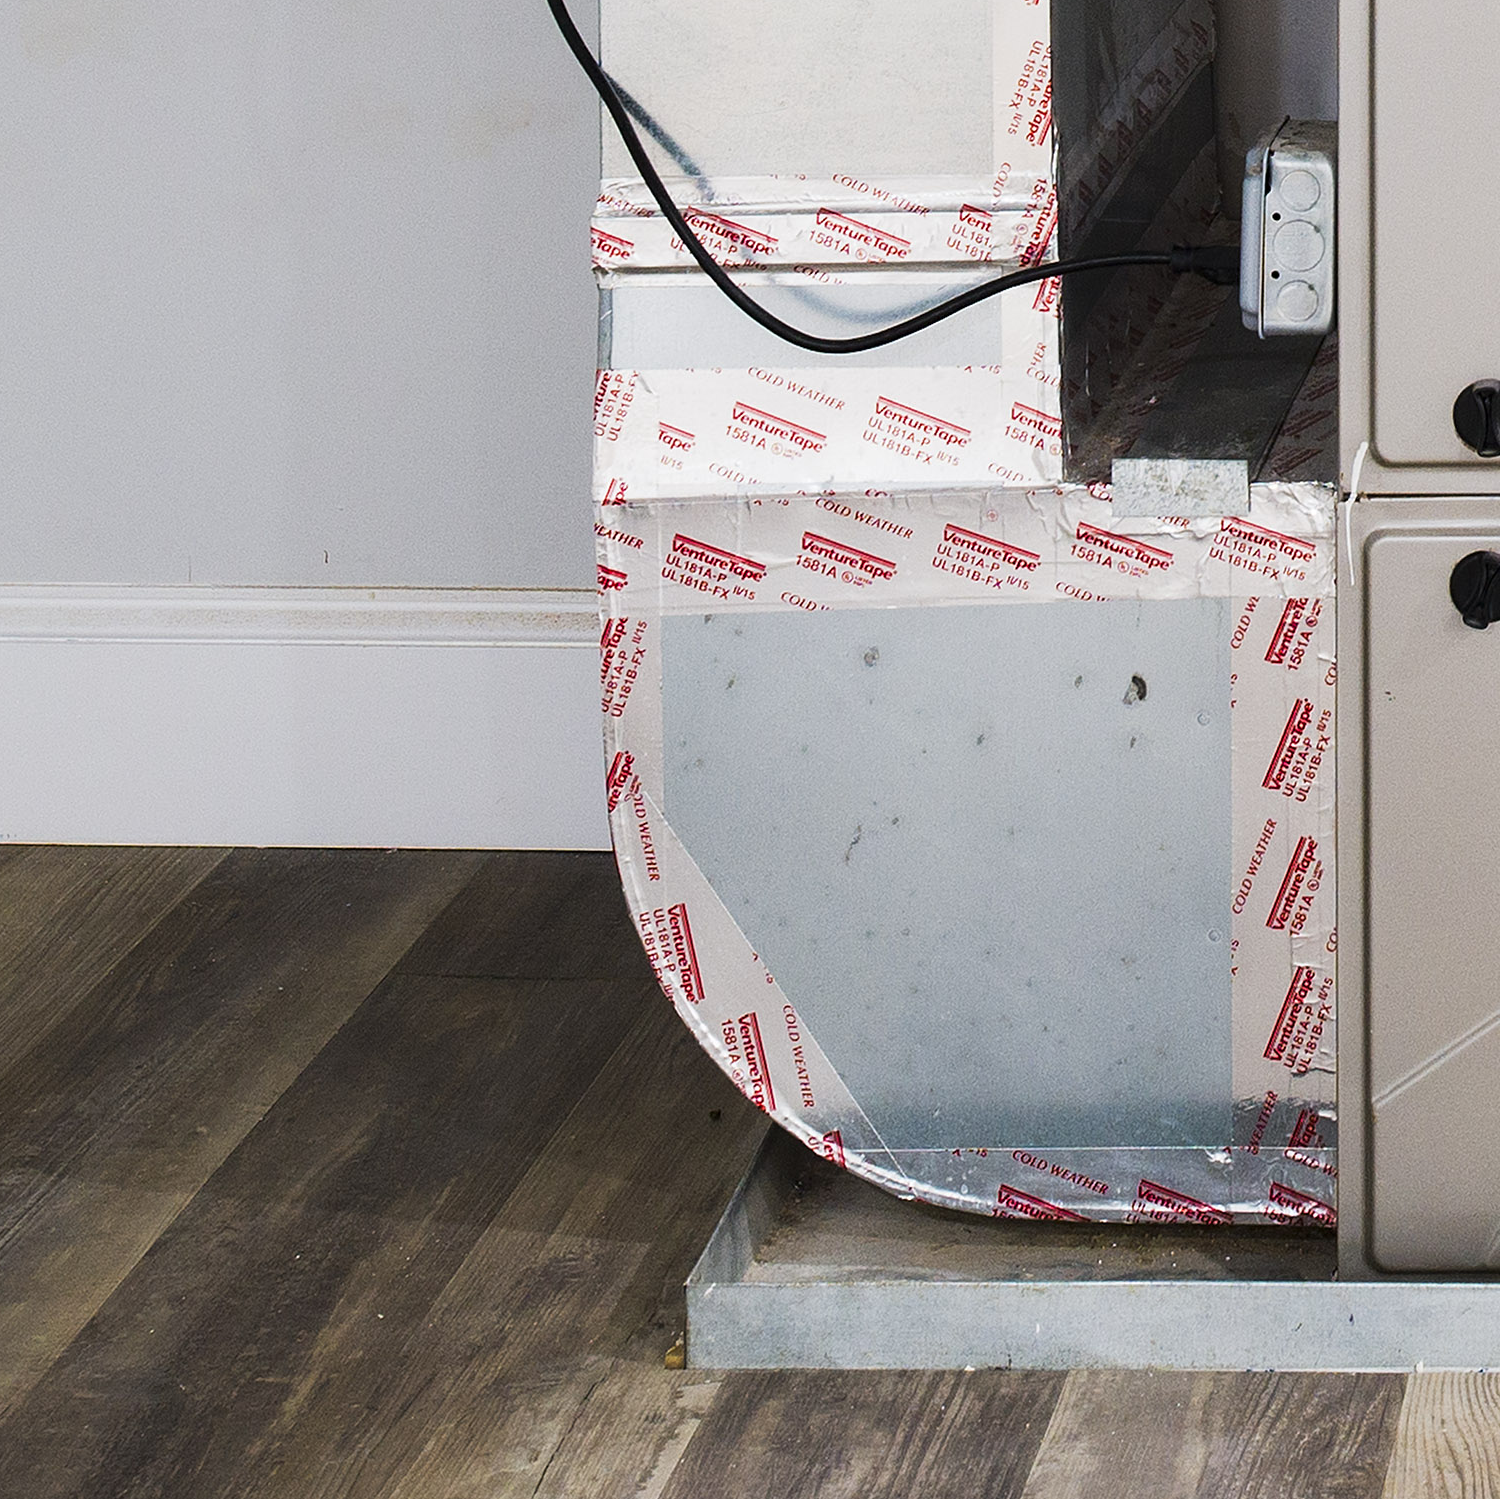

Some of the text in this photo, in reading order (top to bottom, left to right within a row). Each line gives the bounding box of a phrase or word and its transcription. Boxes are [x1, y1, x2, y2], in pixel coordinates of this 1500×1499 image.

[816, 212, 911, 260] VentureTape
[747, 366, 846, 411] COLD WEATHER
[862, 432, 932, 465] UL181B-FX
[867, 417, 931, 448] UL181A-P
[671, 540, 767, 583] VentureTape
[936, 544, 1000, 572] UL181A-P
[1070, 545, 1113, 569] 1581A
[1220, 519, 1316, 563] VentureTape
[932, 556, 1003, 590] UL181B-FX
[1209, 547, 1279, 579] UL181B-FX
[1284, 738, 1313, 796] UL181A-P
[1232, 820, 1277, 915] COLD WEATHER
[783, 1005, 815, 1108] COLD WEATHER
